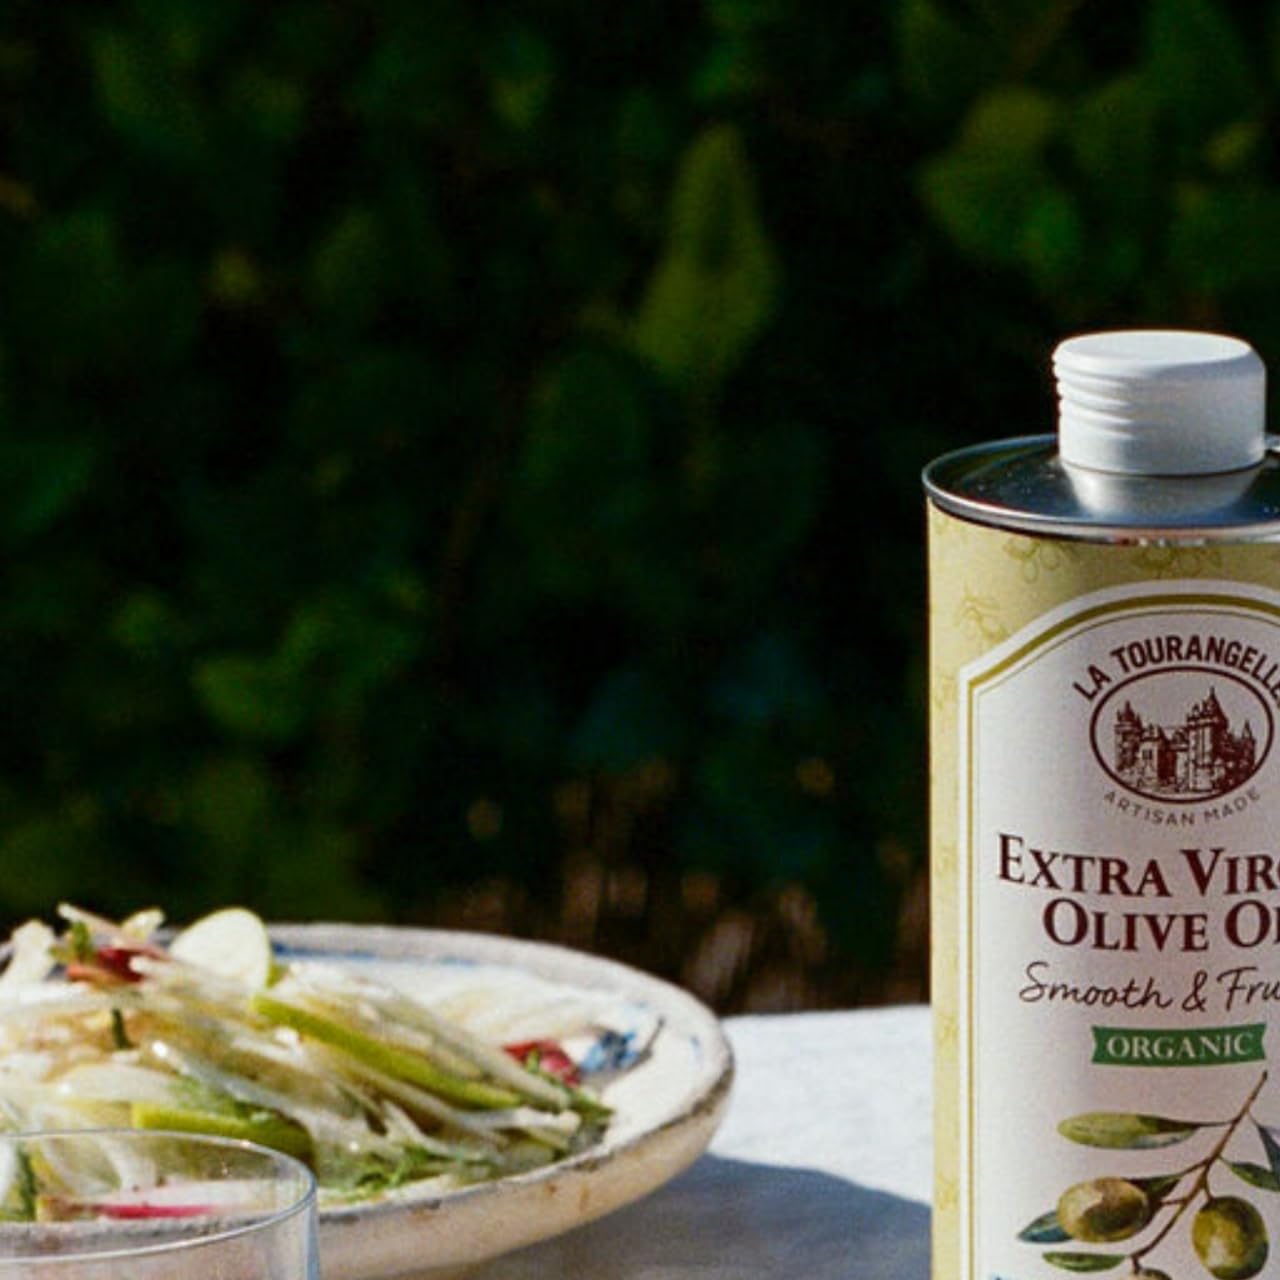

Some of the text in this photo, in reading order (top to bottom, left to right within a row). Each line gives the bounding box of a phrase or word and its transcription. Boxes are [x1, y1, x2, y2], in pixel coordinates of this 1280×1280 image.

[1072, 664, 1113, 701] LA
[1103, 787, 1261, 826] ARTISAN MADE
[997, 832, 1173, 897] EXTRA
[1043, 897, 1209, 952] OLIVE
[1018, 960, 1174, 1009] Smooth
[1181, 969, 1208, 1013] &
[1106, 1031, 1254, 1061] ORGANIC
